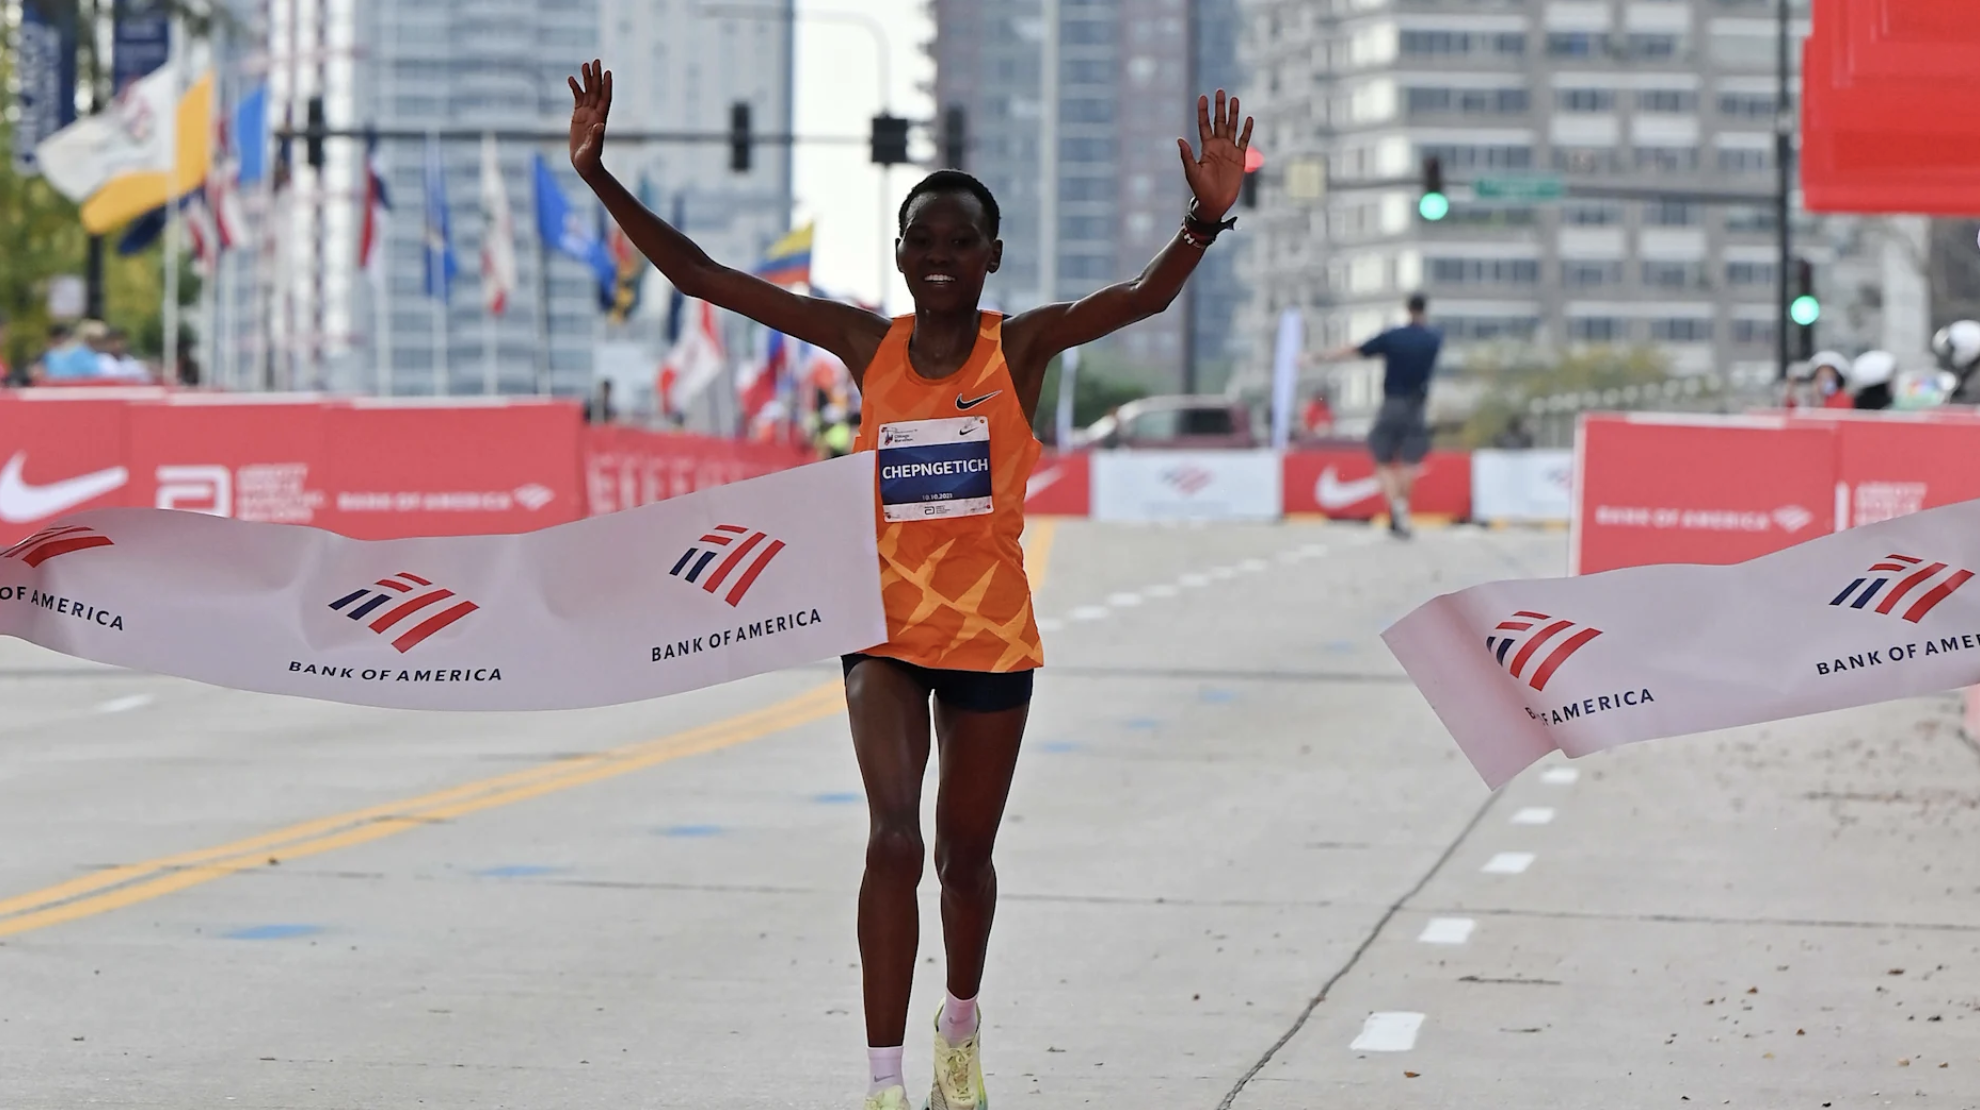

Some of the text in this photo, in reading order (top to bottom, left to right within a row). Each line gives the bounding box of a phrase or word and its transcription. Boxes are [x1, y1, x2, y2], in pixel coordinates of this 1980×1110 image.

[882, 458, 988, 479] CHEPNGETICH
[31, 590, 123, 631] AMERICA
[652, 608, 822, 662] BANK OF AMERICA
[289, 661, 502, 682] BANK OF AMERICA
[1816, 650, 1882, 675] BANK
[1888, 643, 1917, 661] OF
[1551, 689, 1655, 725] AMERICA
